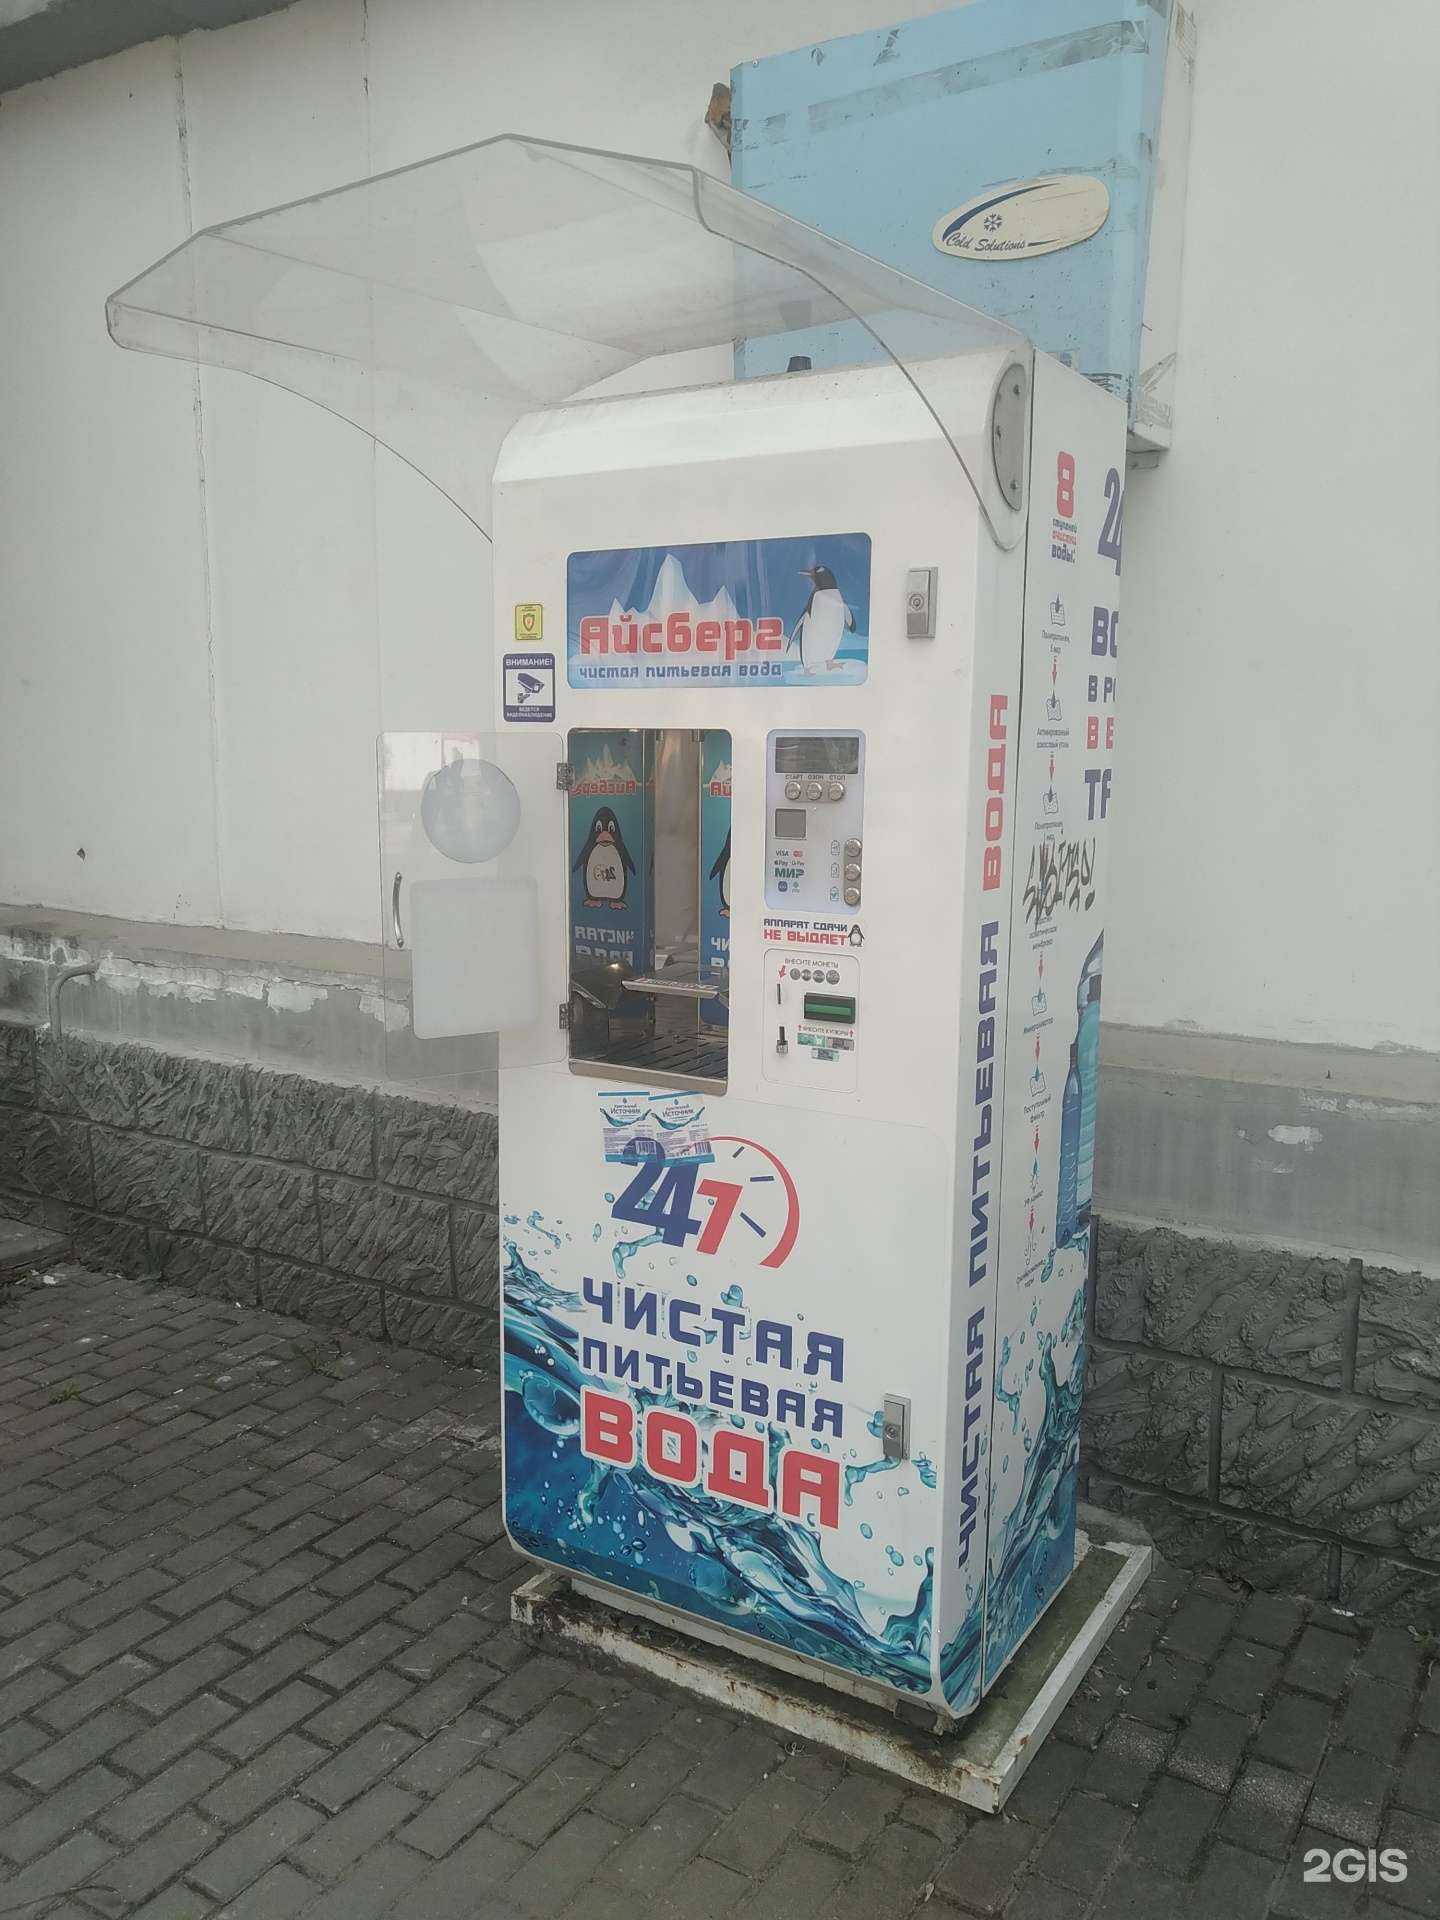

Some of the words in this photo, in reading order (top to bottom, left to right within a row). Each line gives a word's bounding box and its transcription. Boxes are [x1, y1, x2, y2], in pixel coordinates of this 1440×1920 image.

[946, 232, 971, 250] Cold
[974, 238, 1026, 252] Solutions
[1056, 451, 1075, 518] 8
[505, 658, 553, 667] ВНИМАНИЕ!
[580, 613, 783, 660] Айсберг
[579, 665, 639, 679] чистая
[645, 663, 731, 679] питьевая
[739, 660, 782, 677] вода
[983, 694, 1008, 891] ВОДА
[774, 867, 805, 878] МИР
[763, 918, 810, 929] АППАРАТ
[813, 921, 848, 931] СДАЧИ
[763, 929, 782, 940] НЕ
[787, 930, 848, 946] ВЫДАЕТ
[968, 919, 999, 1289] ПИТЬЕВАЯ
[582, 1276, 844, 1383] ЧИСТАЯ
[582, 1336, 843, 1438] ПИТЬЕВАЯ
[583, 1390, 840, 1530] ВОДА
[958, 1306, 985, 1569] ЧИСТАЯ
